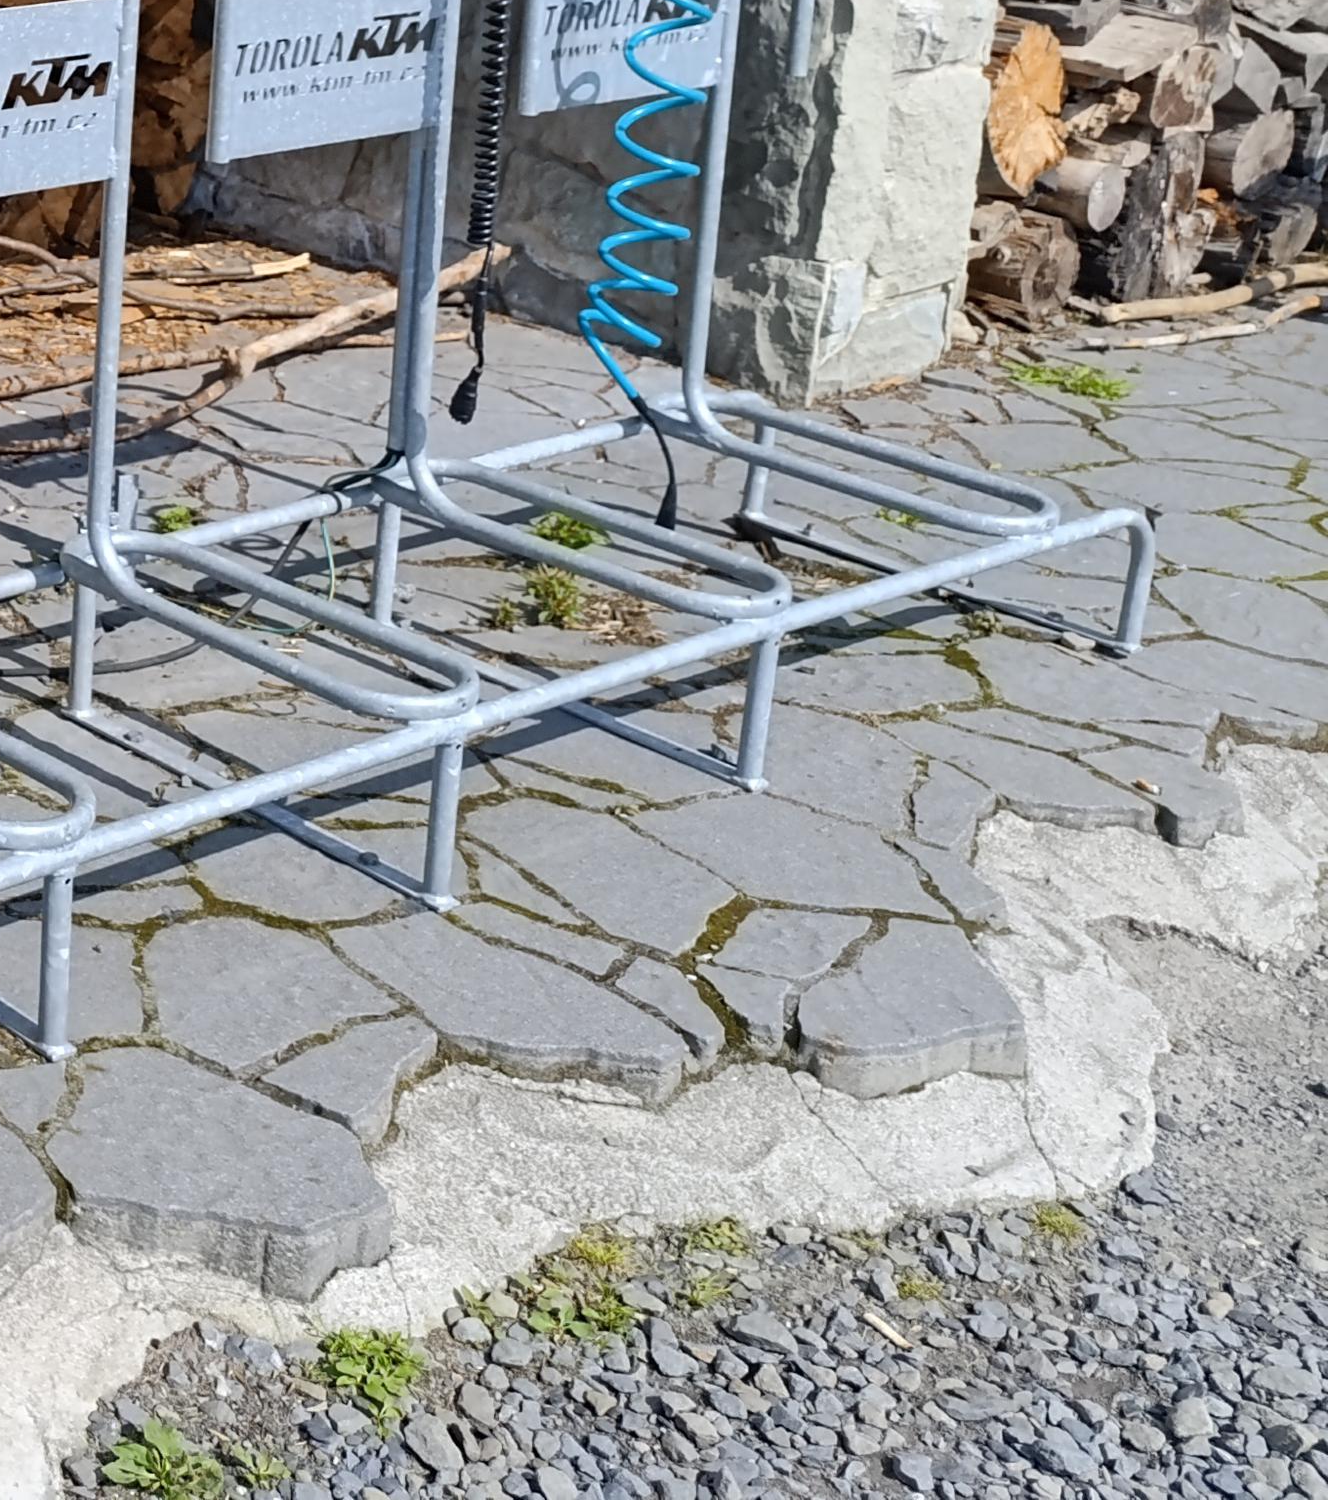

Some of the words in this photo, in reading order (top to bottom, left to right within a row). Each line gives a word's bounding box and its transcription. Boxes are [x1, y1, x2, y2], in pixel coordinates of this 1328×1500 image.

[235, 31, 344, 77] TOROLA
[346, 11, 440, 62] KTM
[0, 53, 113, 110] KTM
